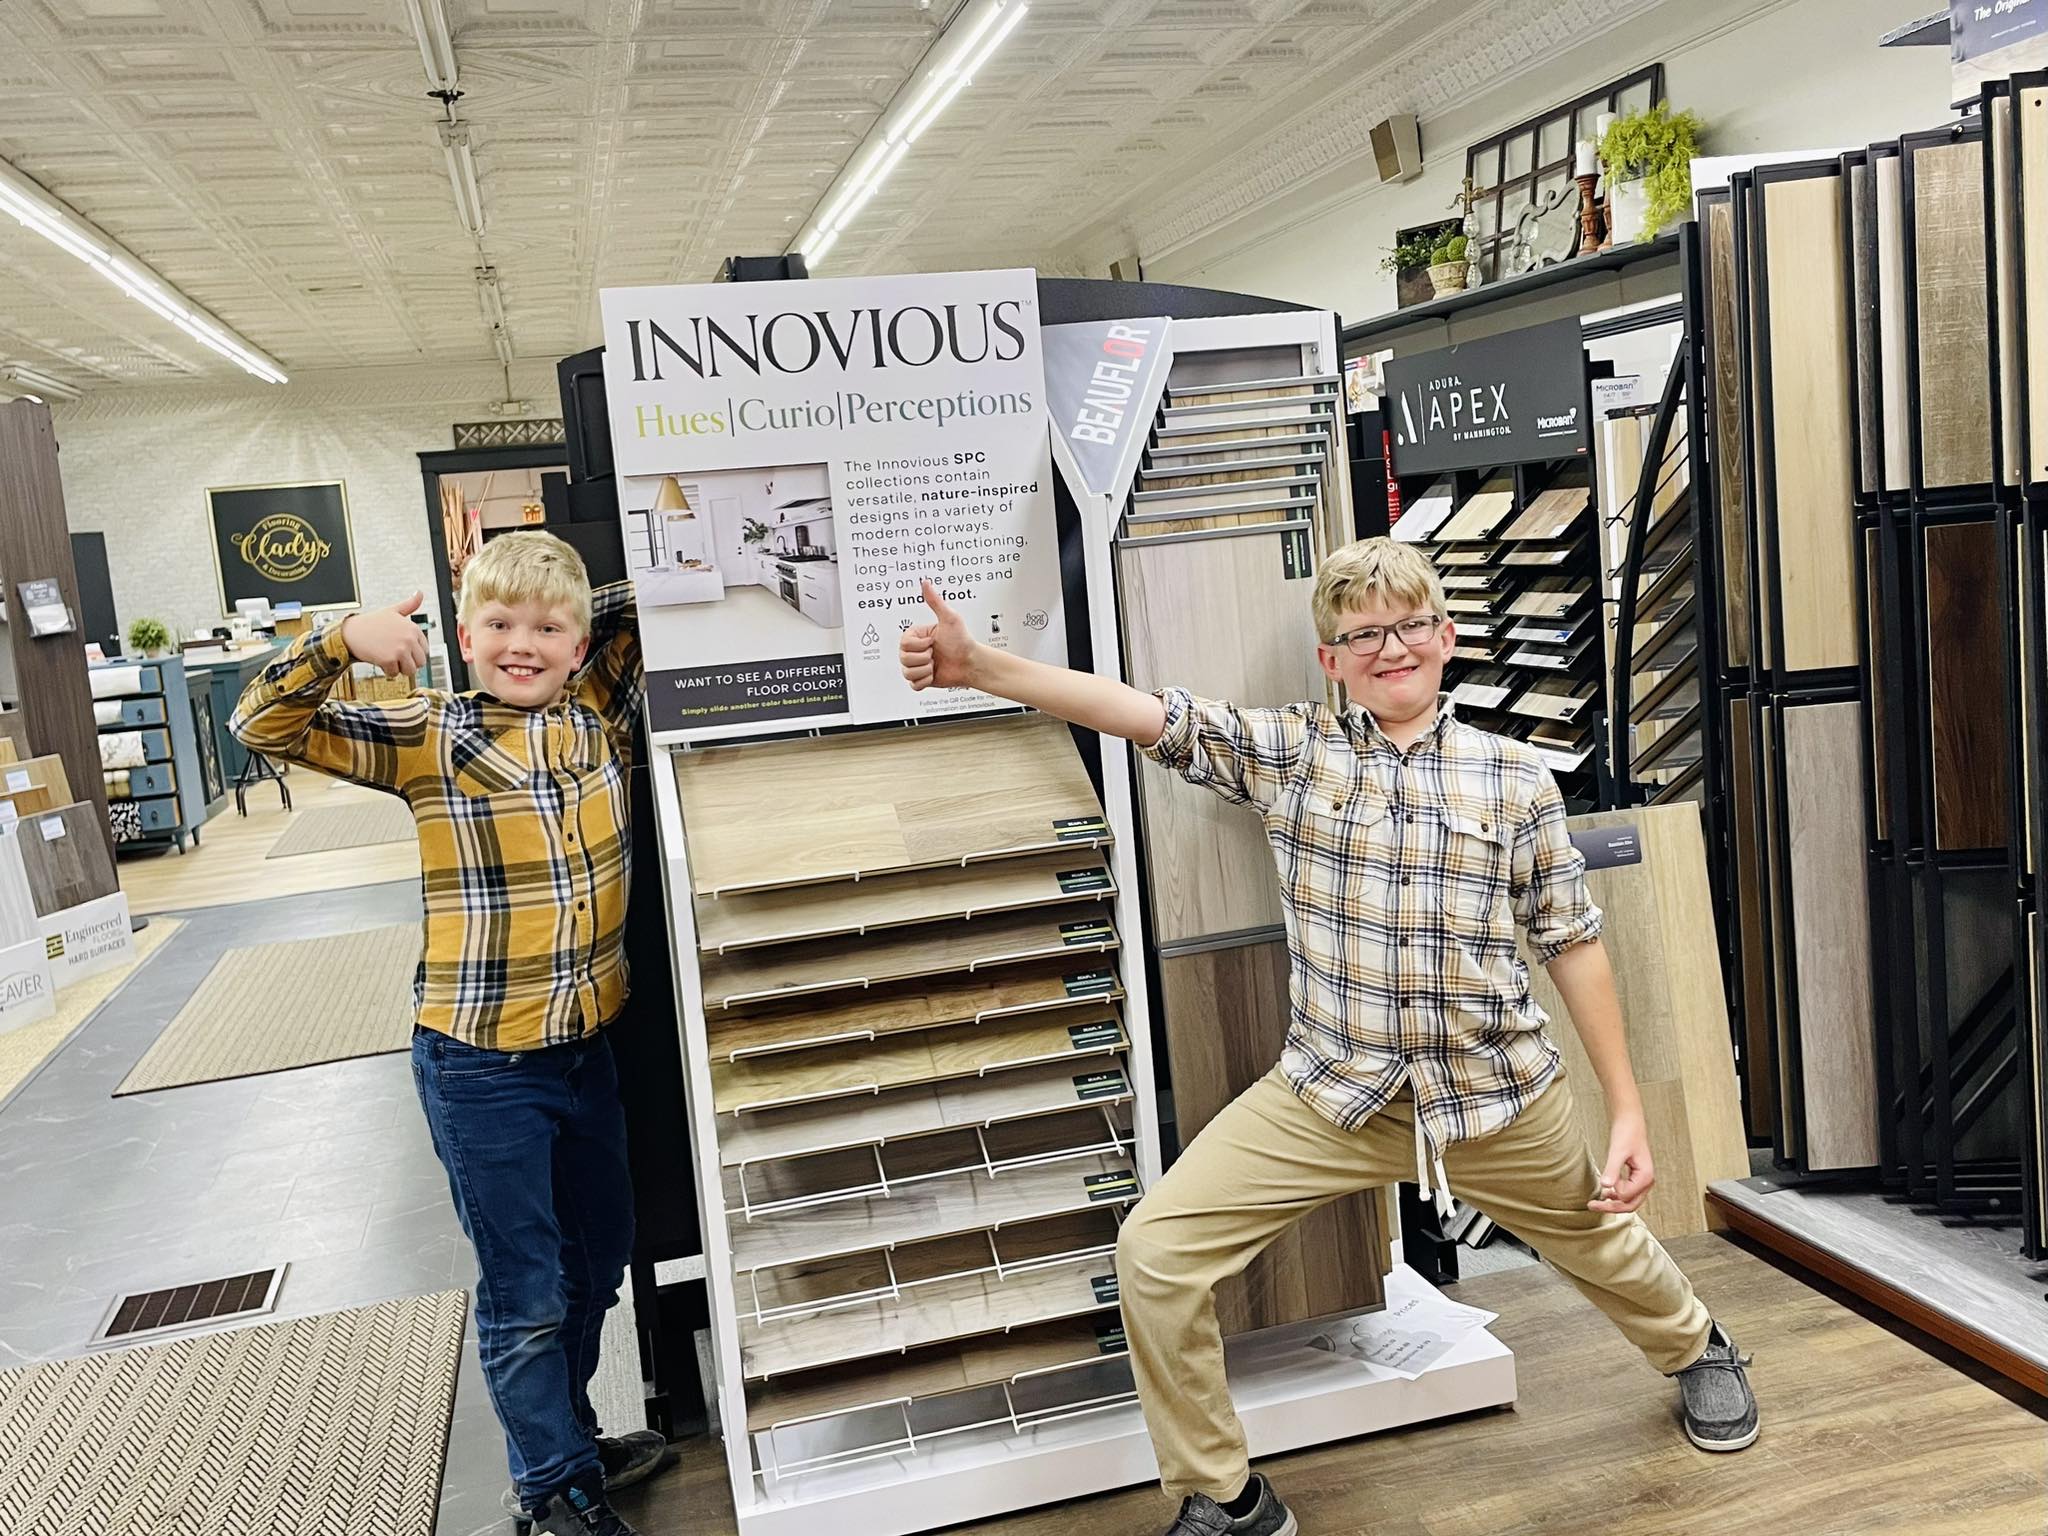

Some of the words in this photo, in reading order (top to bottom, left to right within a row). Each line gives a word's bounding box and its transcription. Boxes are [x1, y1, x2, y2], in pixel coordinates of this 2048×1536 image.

[1974, 7, 1992, 21] The
[626, 300, 1025, 381] INNOVIOUS
[1070, 325, 1150, 445] BEAUFLOR
[1429, 376, 1461, 391] ADURA
[635, 404, 725, 439] Hues
[738, 398, 835, 432] Curio
[847, 389, 1033, 428] Perceptions
[1429, 383, 1509, 431] APEX
[1453, 432, 1461, 441] BY
[1464, 426, 1511, 440] MANNINGTON
[844, 460, 872, 473] The
[877, 455, 949, 471] Innovious
[954, 452, 986, 465] SPC
[846, 473, 930, 490] collections
[935, 469, 990, 484] contain
[848, 492, 917, 507] versatile,
[921, 482, 1038, 501] nature-inspired
[850, 507, 909, 525] designs
[915, 508, 927, 519] in
[932, 508, 940, 518] a
[945, 501, 994, 517] variety
[1000, 500, 1013, 512] of
[851, 527, 909, 541] modern
[915, 521, 993, 536] colorways.
[853, 543, 898, 558] These
[904, 541, 935, 556] high
[854, 557, 945, 576] long-lasting
[951, 554, 993, 567] floors
[998, 551, 1021, 562] are
[856, 581, 890, 592] easy
[896, 578, 913, 589] on
[948, 572, 981, 586] eyes
[987, 568, 1013, 579] and
[858, 596, 893, 609] easy
[898, 589, 976, 605] undfoot.
[675, 677, 712, 689] WANT
[716, 675, 733, 684] TO
[736, 671, 760, 683] SEE
[764, 671, 772, 680] A
[776, 664, 842, 679] DIFFERENT
[747, 682, 789, 697] FLOOR
[792, 679, 844, 692] COLOR?
[730, 702, 760, 710] another
[783, 697, 804, 705] board
[65, 912, 122, 943] Engineered
[68, 951, 89, 966] HARD
[90, 937, 126, 958] SURFACES
